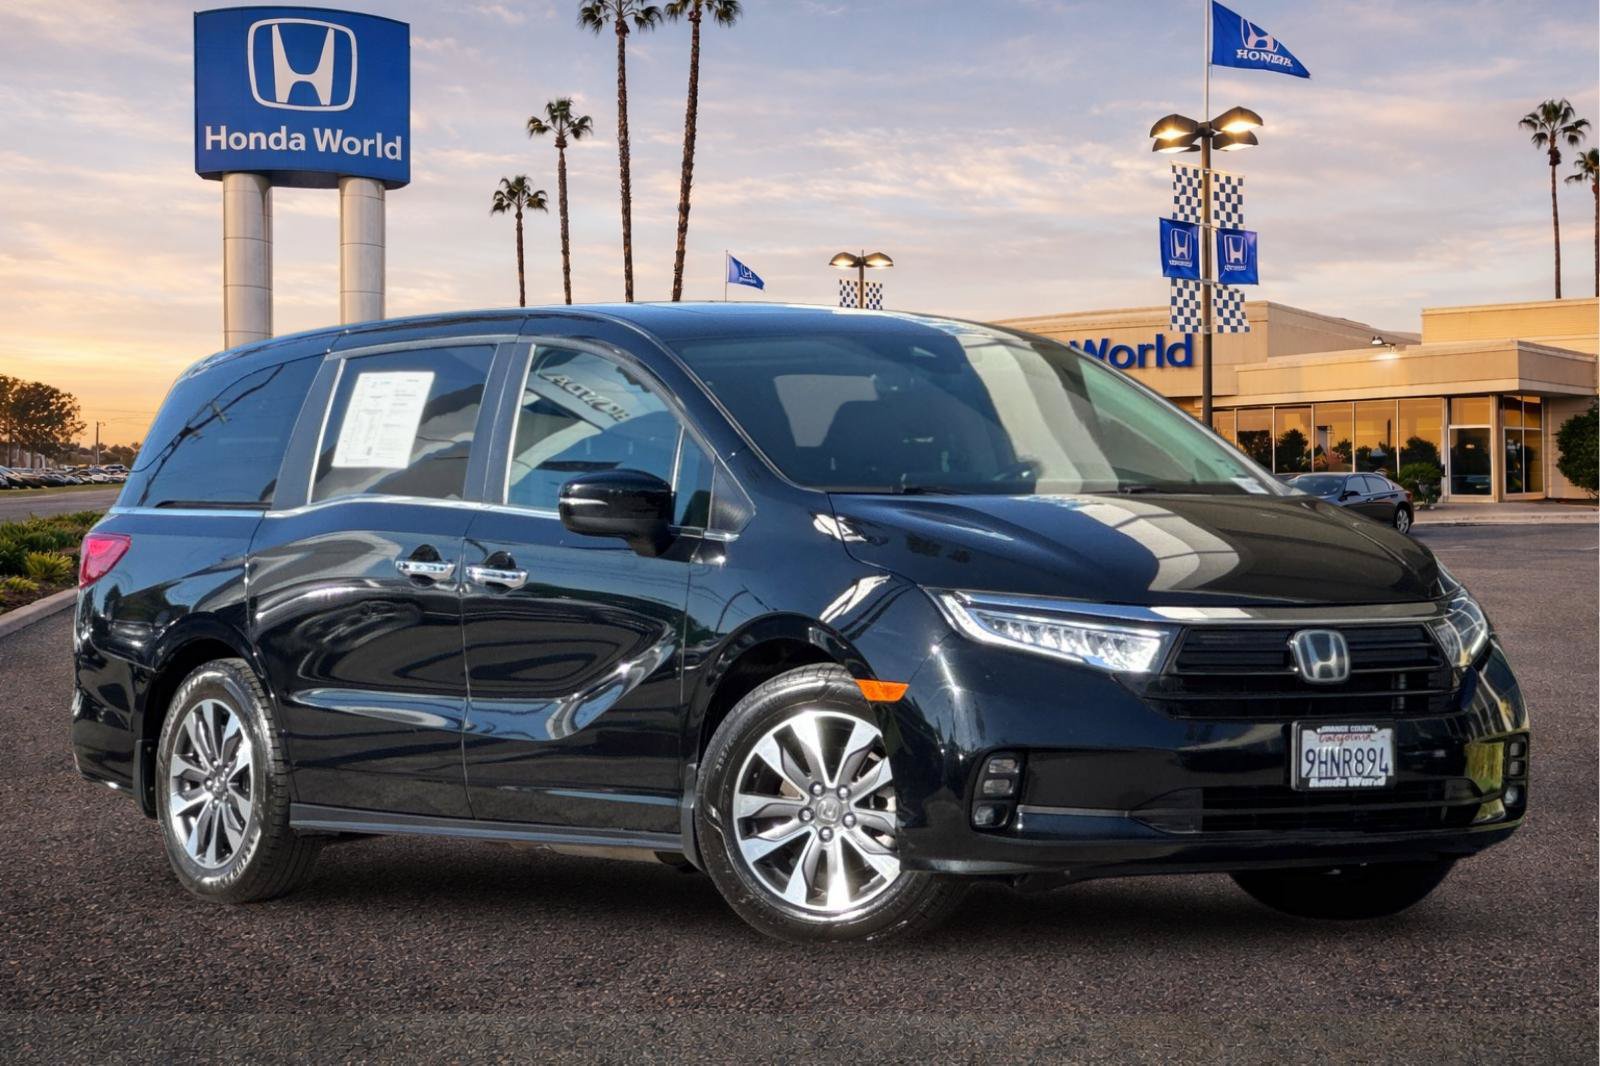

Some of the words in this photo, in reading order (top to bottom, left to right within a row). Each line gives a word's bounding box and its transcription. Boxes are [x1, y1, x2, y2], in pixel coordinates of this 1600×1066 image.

[205, 125, 306, 151] Honda
[312, 127, 402, 161] World
[1305, 747, 1389, 777] 9HNR894
